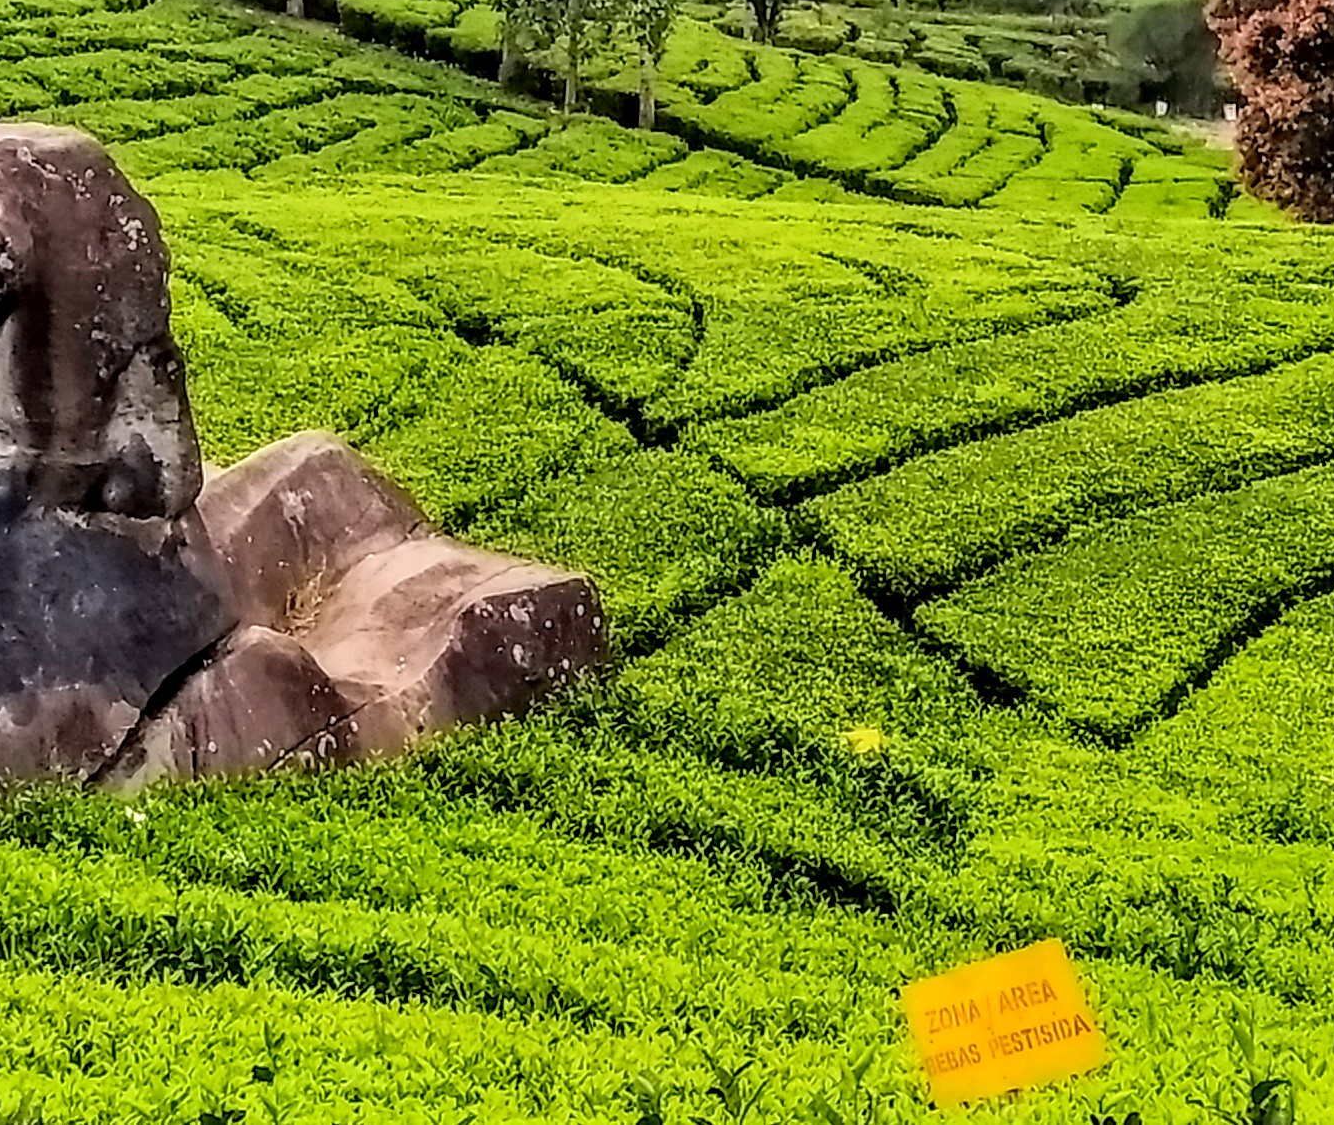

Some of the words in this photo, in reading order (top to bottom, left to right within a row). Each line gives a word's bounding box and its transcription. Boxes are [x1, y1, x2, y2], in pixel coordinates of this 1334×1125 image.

[924, 998, 981, 1034] ZONA
[998, 978, 1058, 1015] AREA
[987, 1013, 1092, 1059] PESTISIDA
